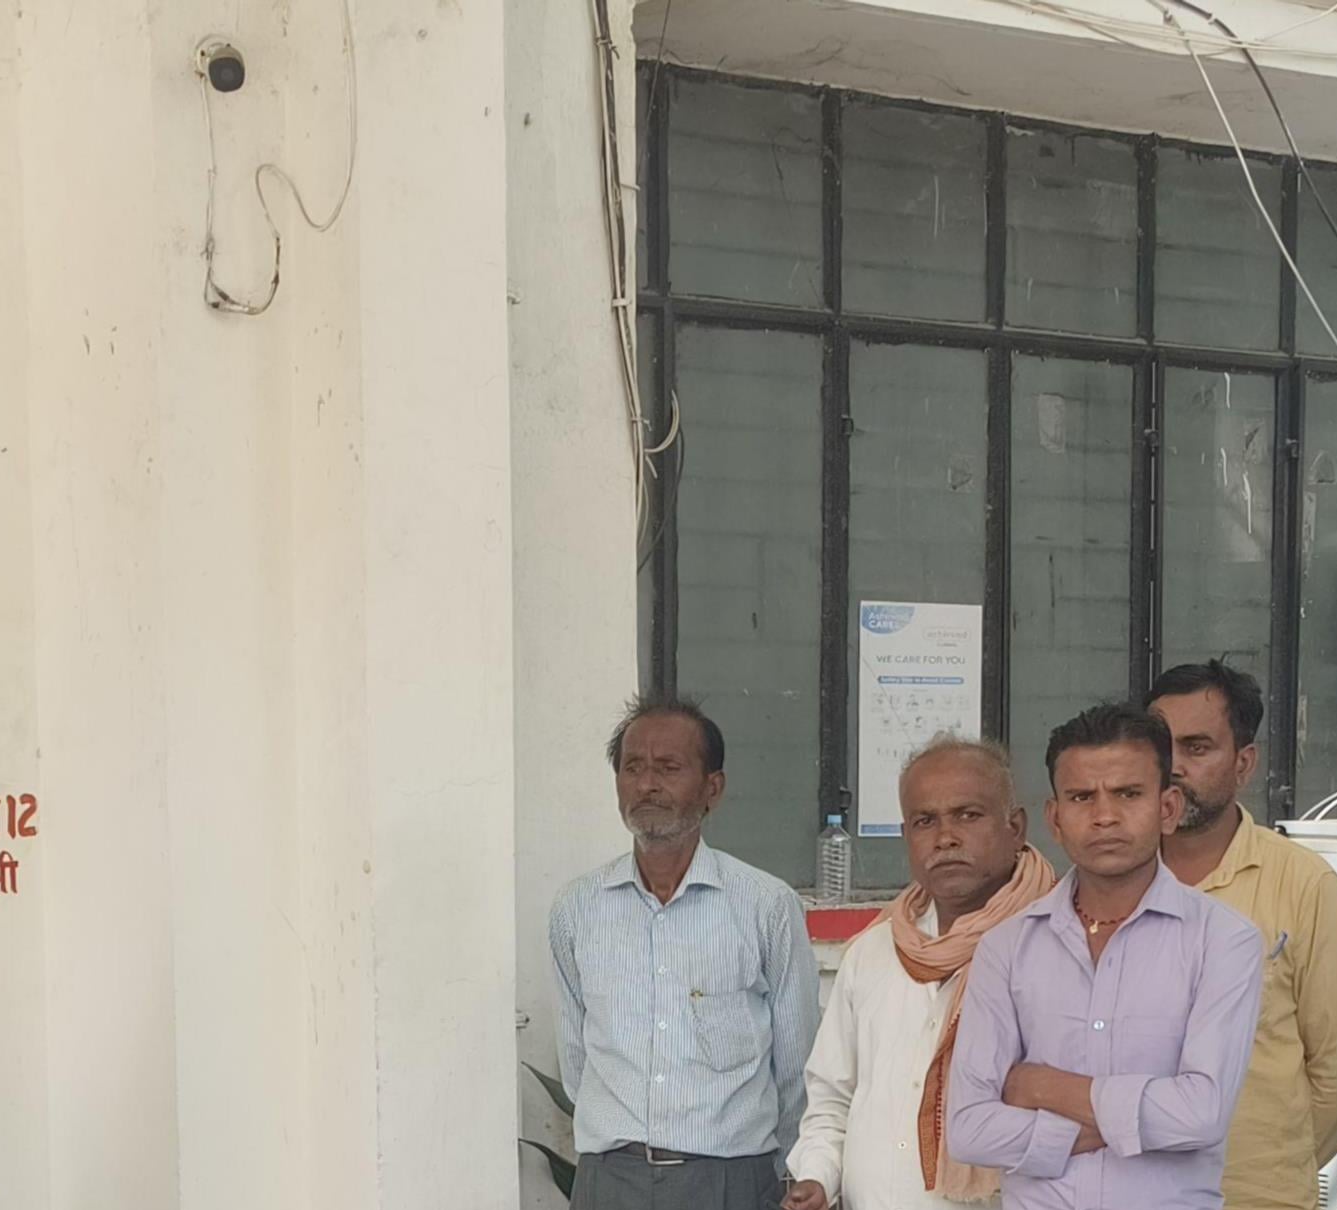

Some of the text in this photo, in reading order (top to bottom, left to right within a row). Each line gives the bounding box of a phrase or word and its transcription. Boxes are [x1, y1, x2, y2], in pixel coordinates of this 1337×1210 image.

[876, 655, 966, 665] WE CARE FOR YOU
[6, 793, 38, 839] 12
